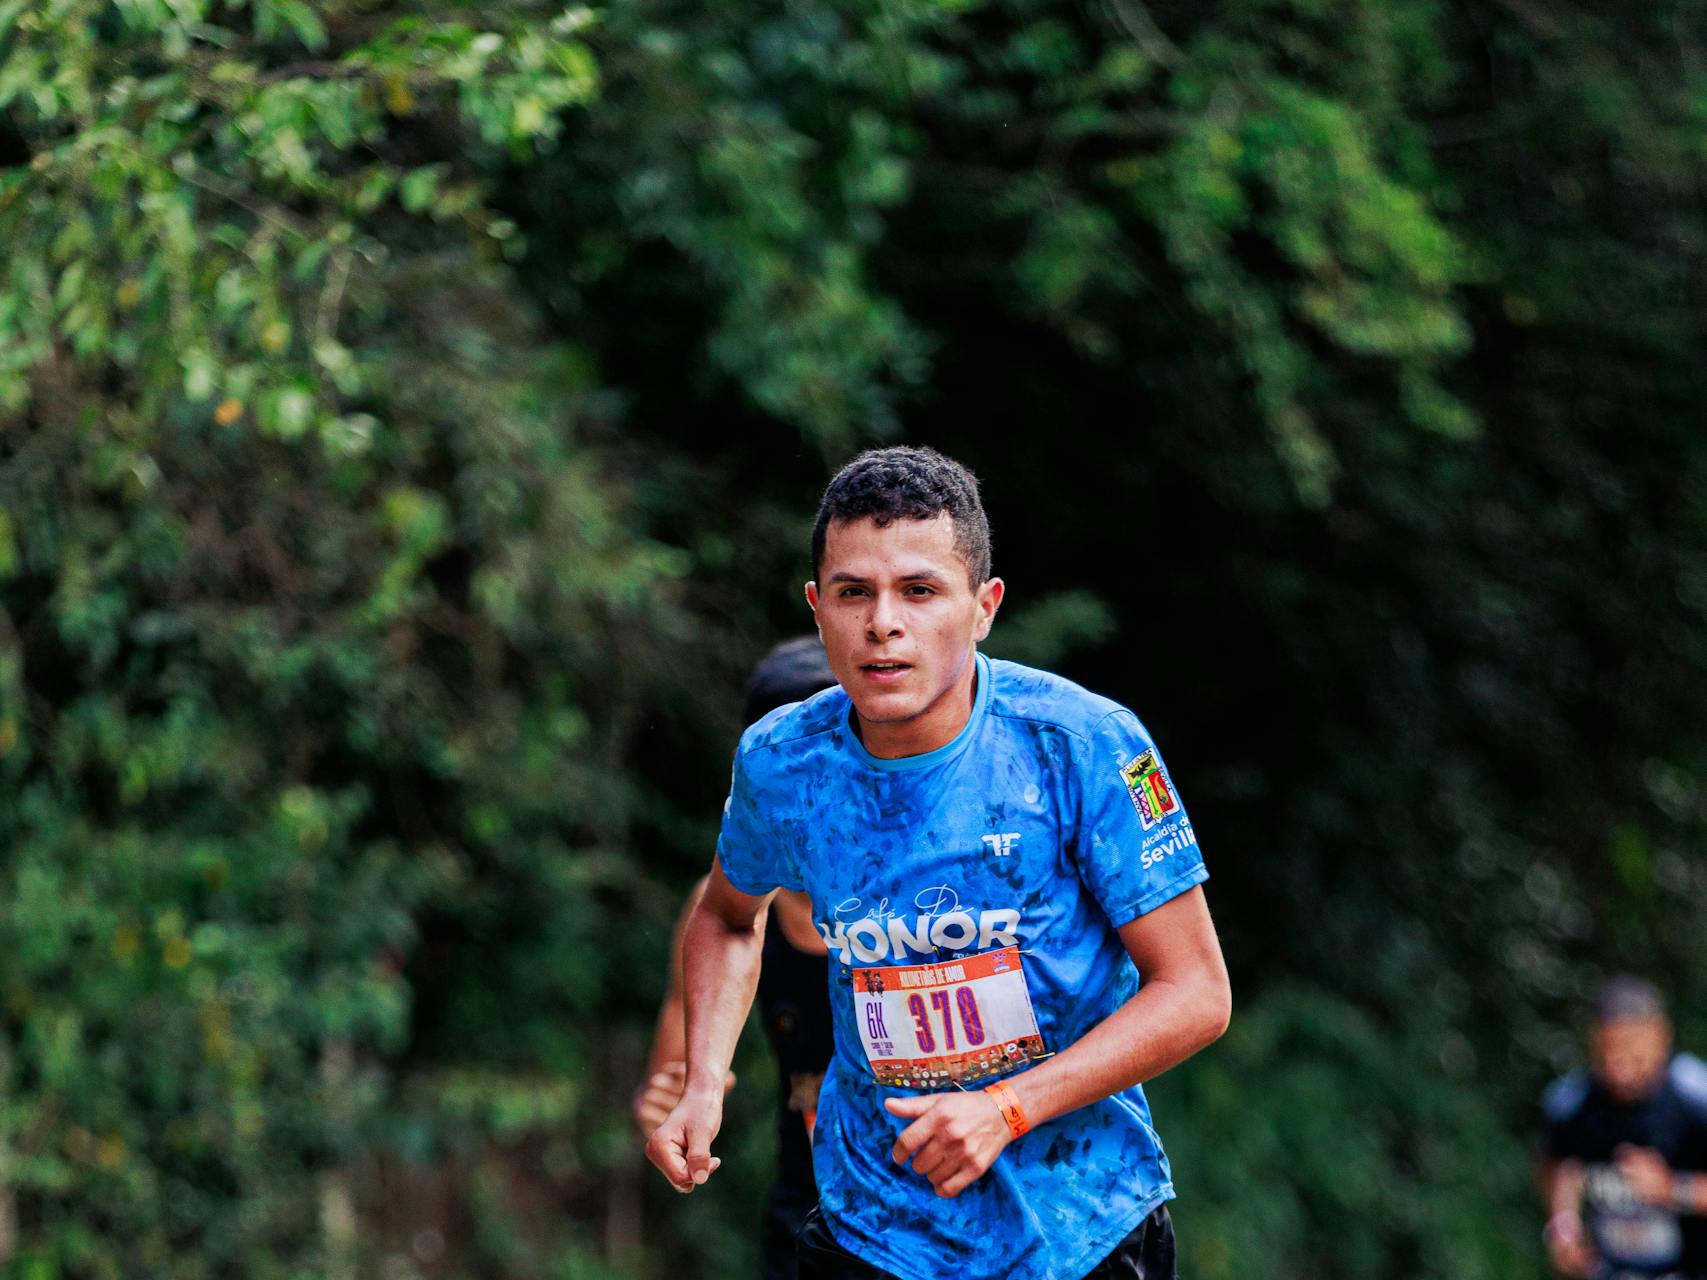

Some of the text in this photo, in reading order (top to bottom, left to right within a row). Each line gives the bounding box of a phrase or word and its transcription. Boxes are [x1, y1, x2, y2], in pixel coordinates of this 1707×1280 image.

[914, 883, 975, 918] De
[818, 907, 1020, 965] HONOR
[866, 1001, 889, 1040] 6K
[908, 985, 985, 1054] 370
